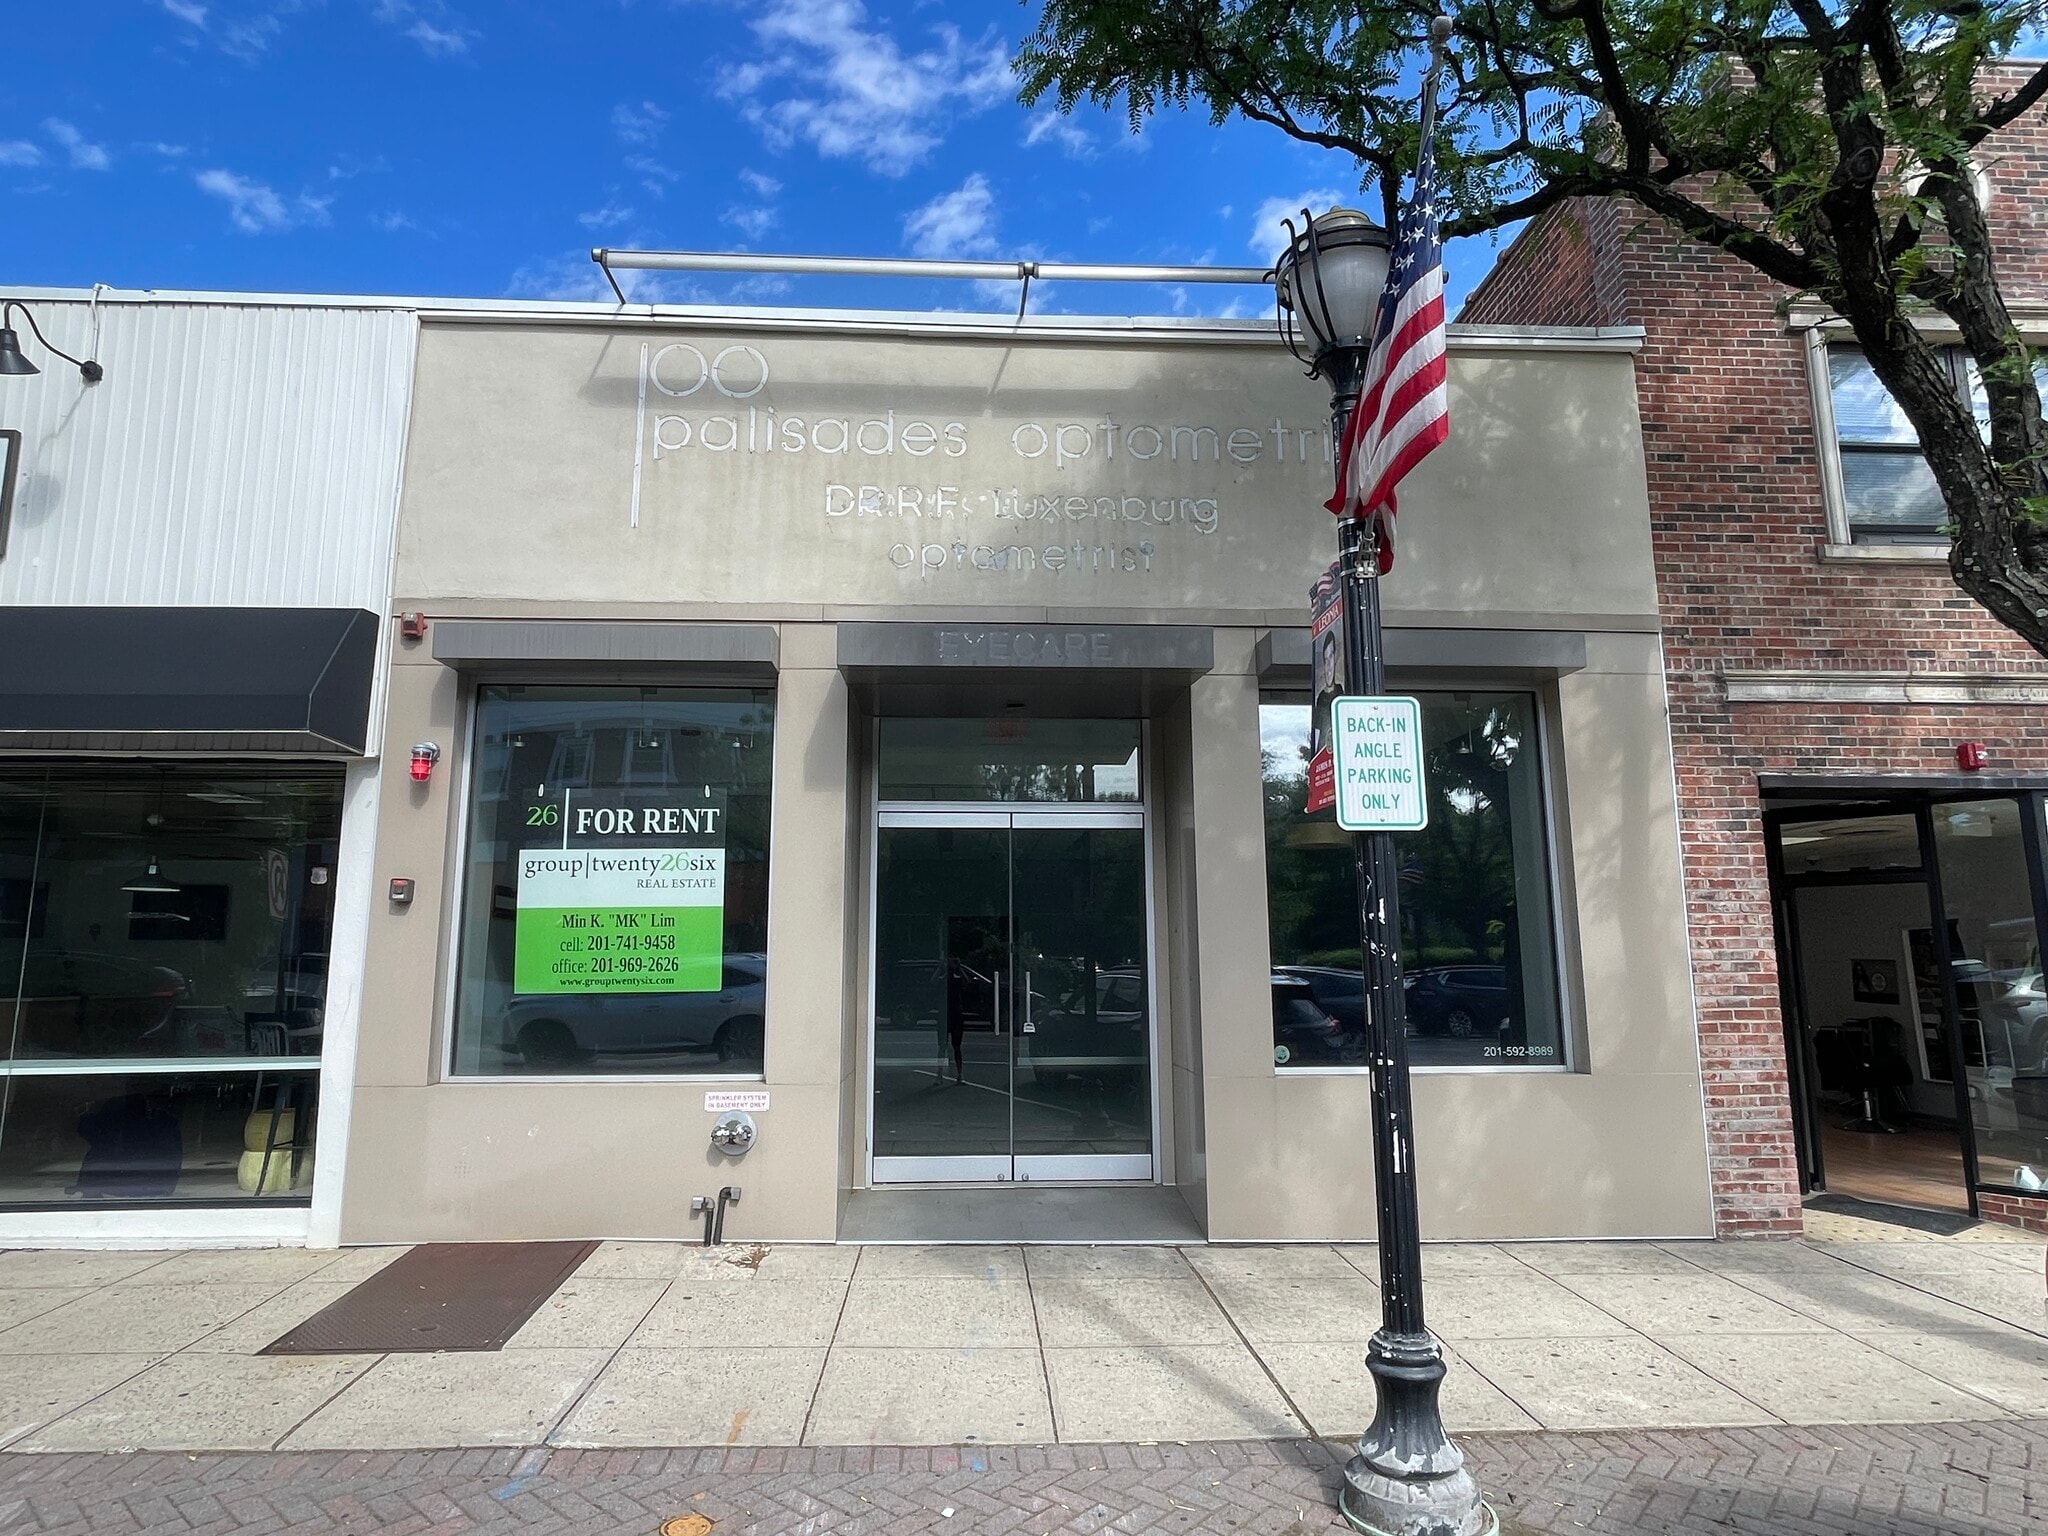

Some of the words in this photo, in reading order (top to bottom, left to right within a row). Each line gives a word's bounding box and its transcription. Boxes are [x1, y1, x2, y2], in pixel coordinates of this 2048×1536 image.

[653, 405, 968, 460] palisades
[1011, 412, 1331, 471] optometri
[889, 538, 1155, 580] optometrist
[939, 631, 1113, 661] EYECARE
[1347, 717, 1406, 733] BACK-IN
[1354, 743, 1402, 758] ANGLE
[1348, 768, 1412, 784] PARKING
[1362, 794, 1400, 809] ONLY
[526, 804, 559, 827] 26
[575, 808, 636, 834] FOR
[642, 808, 720, 834] RENT
[637, 879, 668, 888] REAL
[671, 878, 717, 888] ESTATE
[562, 914, 586, 928] Min
[590, 914, 604, 928] K.
[608, 913, 646, 928] "MK"
[651, 913, 675, 927] Lim
[560, 937, 583, 951] cell:
[587, 935, 675, 951] 201-741-9458
[552, 958, 587, 973] office:
[591, 957, 679, 973] 201-969-2626
[559, 977, 675, 987] www.grouptwentysix.com
[1483, 1046, 1554, 1057] 201-592-8989
